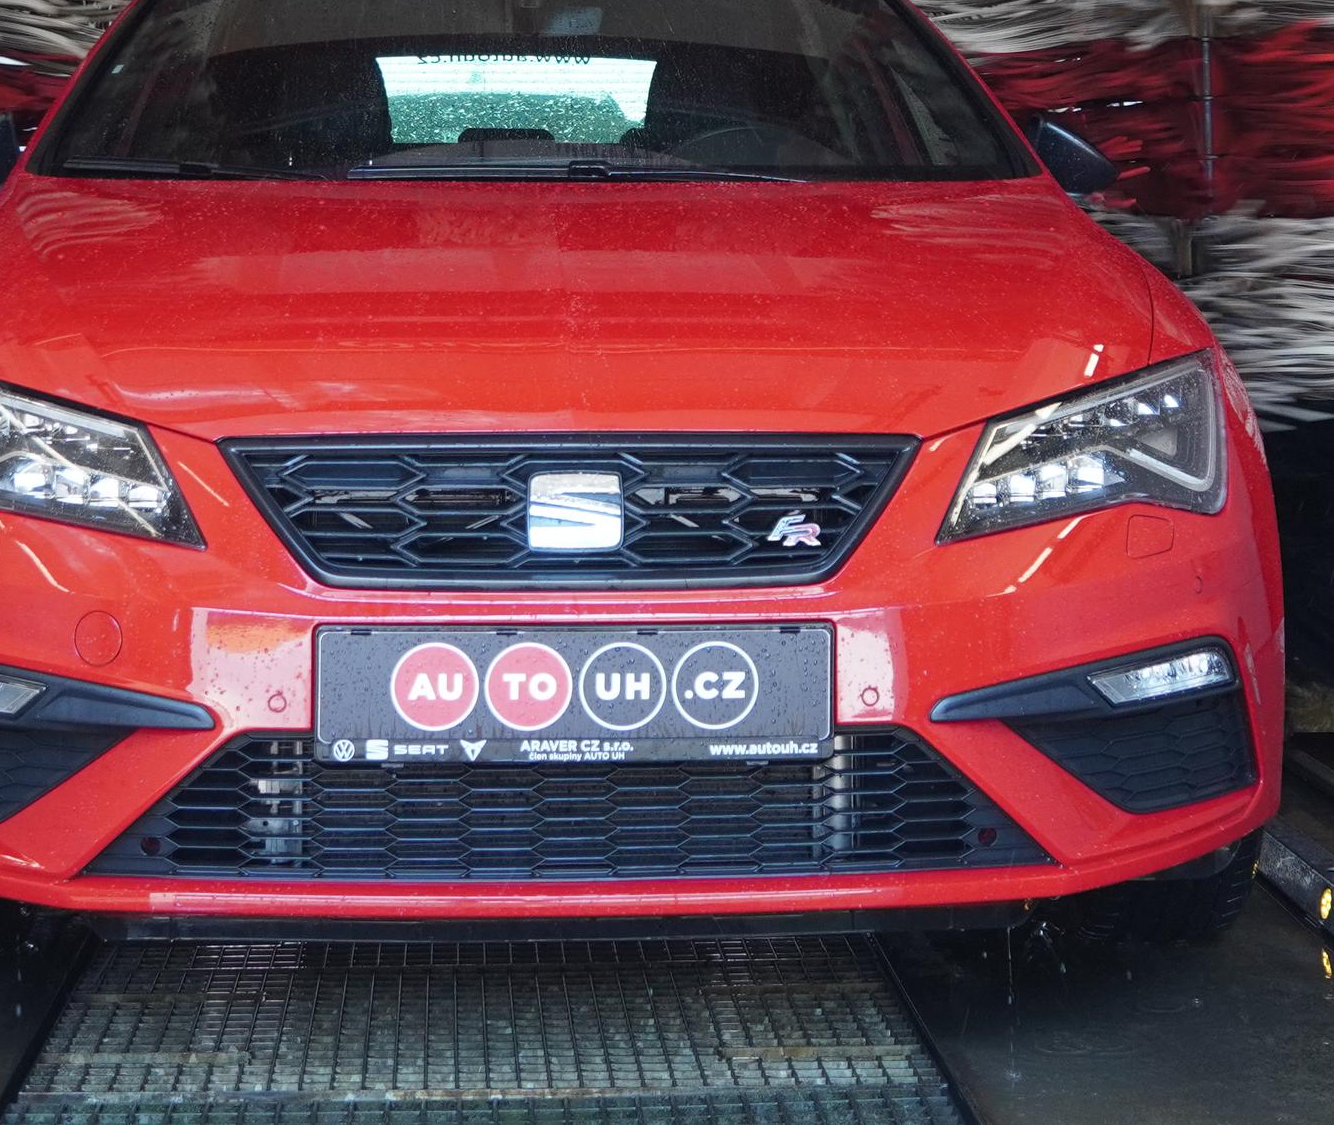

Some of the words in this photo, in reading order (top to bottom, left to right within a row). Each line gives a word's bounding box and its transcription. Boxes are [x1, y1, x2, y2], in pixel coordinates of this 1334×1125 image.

[767, 515, 821, 546] FR
[408, 673, 463, 700] AU
[503, 673, 557, 700] TO
[595, 673, 650, 700] UH
[684, 671, 746, 699] .CZ
[394, 744, 449, 755] SEAT
[520, 740, 577, 752] ARAVER
[580, 740, 600, 752] CZ
[603, 741, 634, 751] s.r.o.
[709, 741, 818, 755] www.autouh.cz
[549, 751, 582, 762] skupiny
[584, 752, 610, 760] AUTO
[612, 752, 625, 760] UH
